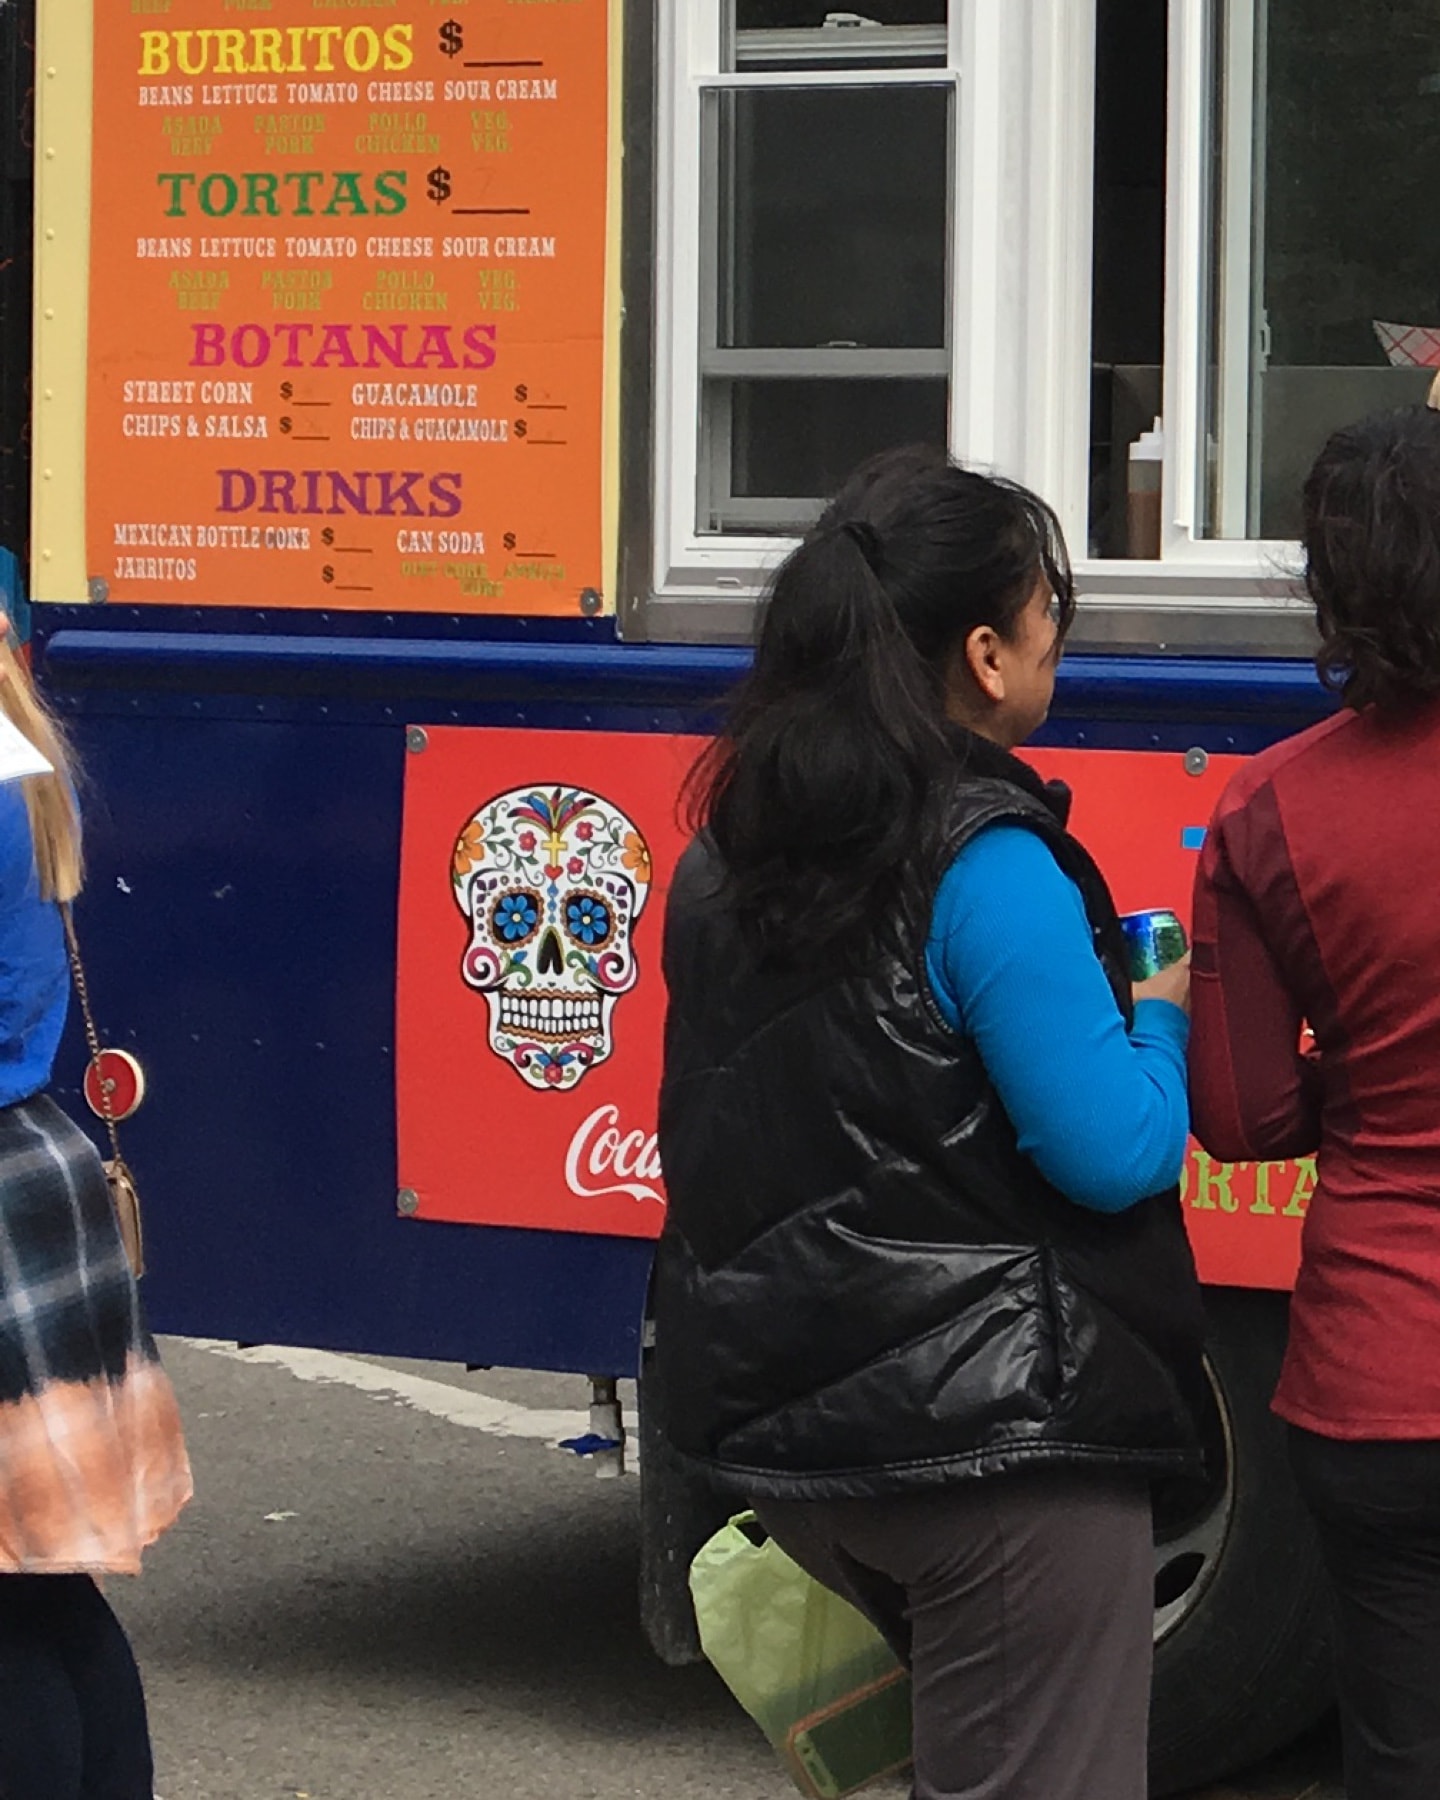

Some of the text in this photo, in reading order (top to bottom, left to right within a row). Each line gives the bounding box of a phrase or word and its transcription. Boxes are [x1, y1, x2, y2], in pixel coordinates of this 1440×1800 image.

[138, 25, 413, 74] BURRITOS
[139, 80, 556, 105] BEANS LETTUCE TOMATO CHEESE SOUR CREAM
[159, 171, 407, 216] TORTAS
[137, 237, 555, 257] BEANS LETTUCE TOMATO CHEESE SOUR CREAM
[189, 324, 496, 369] BOTANAS
[124, 381, 195, 403] STREET
[201, 381, 252, 404] CORN
[352, 383, 477, 407] GUACAMOLE
[123, 414, 180, 436] CHIPS
[187, 416, 199, 437] &
[206, 416, 267, 437] SALSA
[351, 417, 397, 440] CHIPS
[399, 418, 410, 440] &
[414, 418, 508, 441] GUACAMOLE
[217, 470, 462, 517] DRINKS
[114, 524, 192, 546] MEXICAN
[197, 526, 263, 548] BOTTLE
[263, 527, 310, 549] COKE
[397, 530, 433, 553] CAN
[438, 531, 484, 554] SODA
[115, 557, 196, 580] JARRITOS
[565, 1103, 665, 1203] Coca
